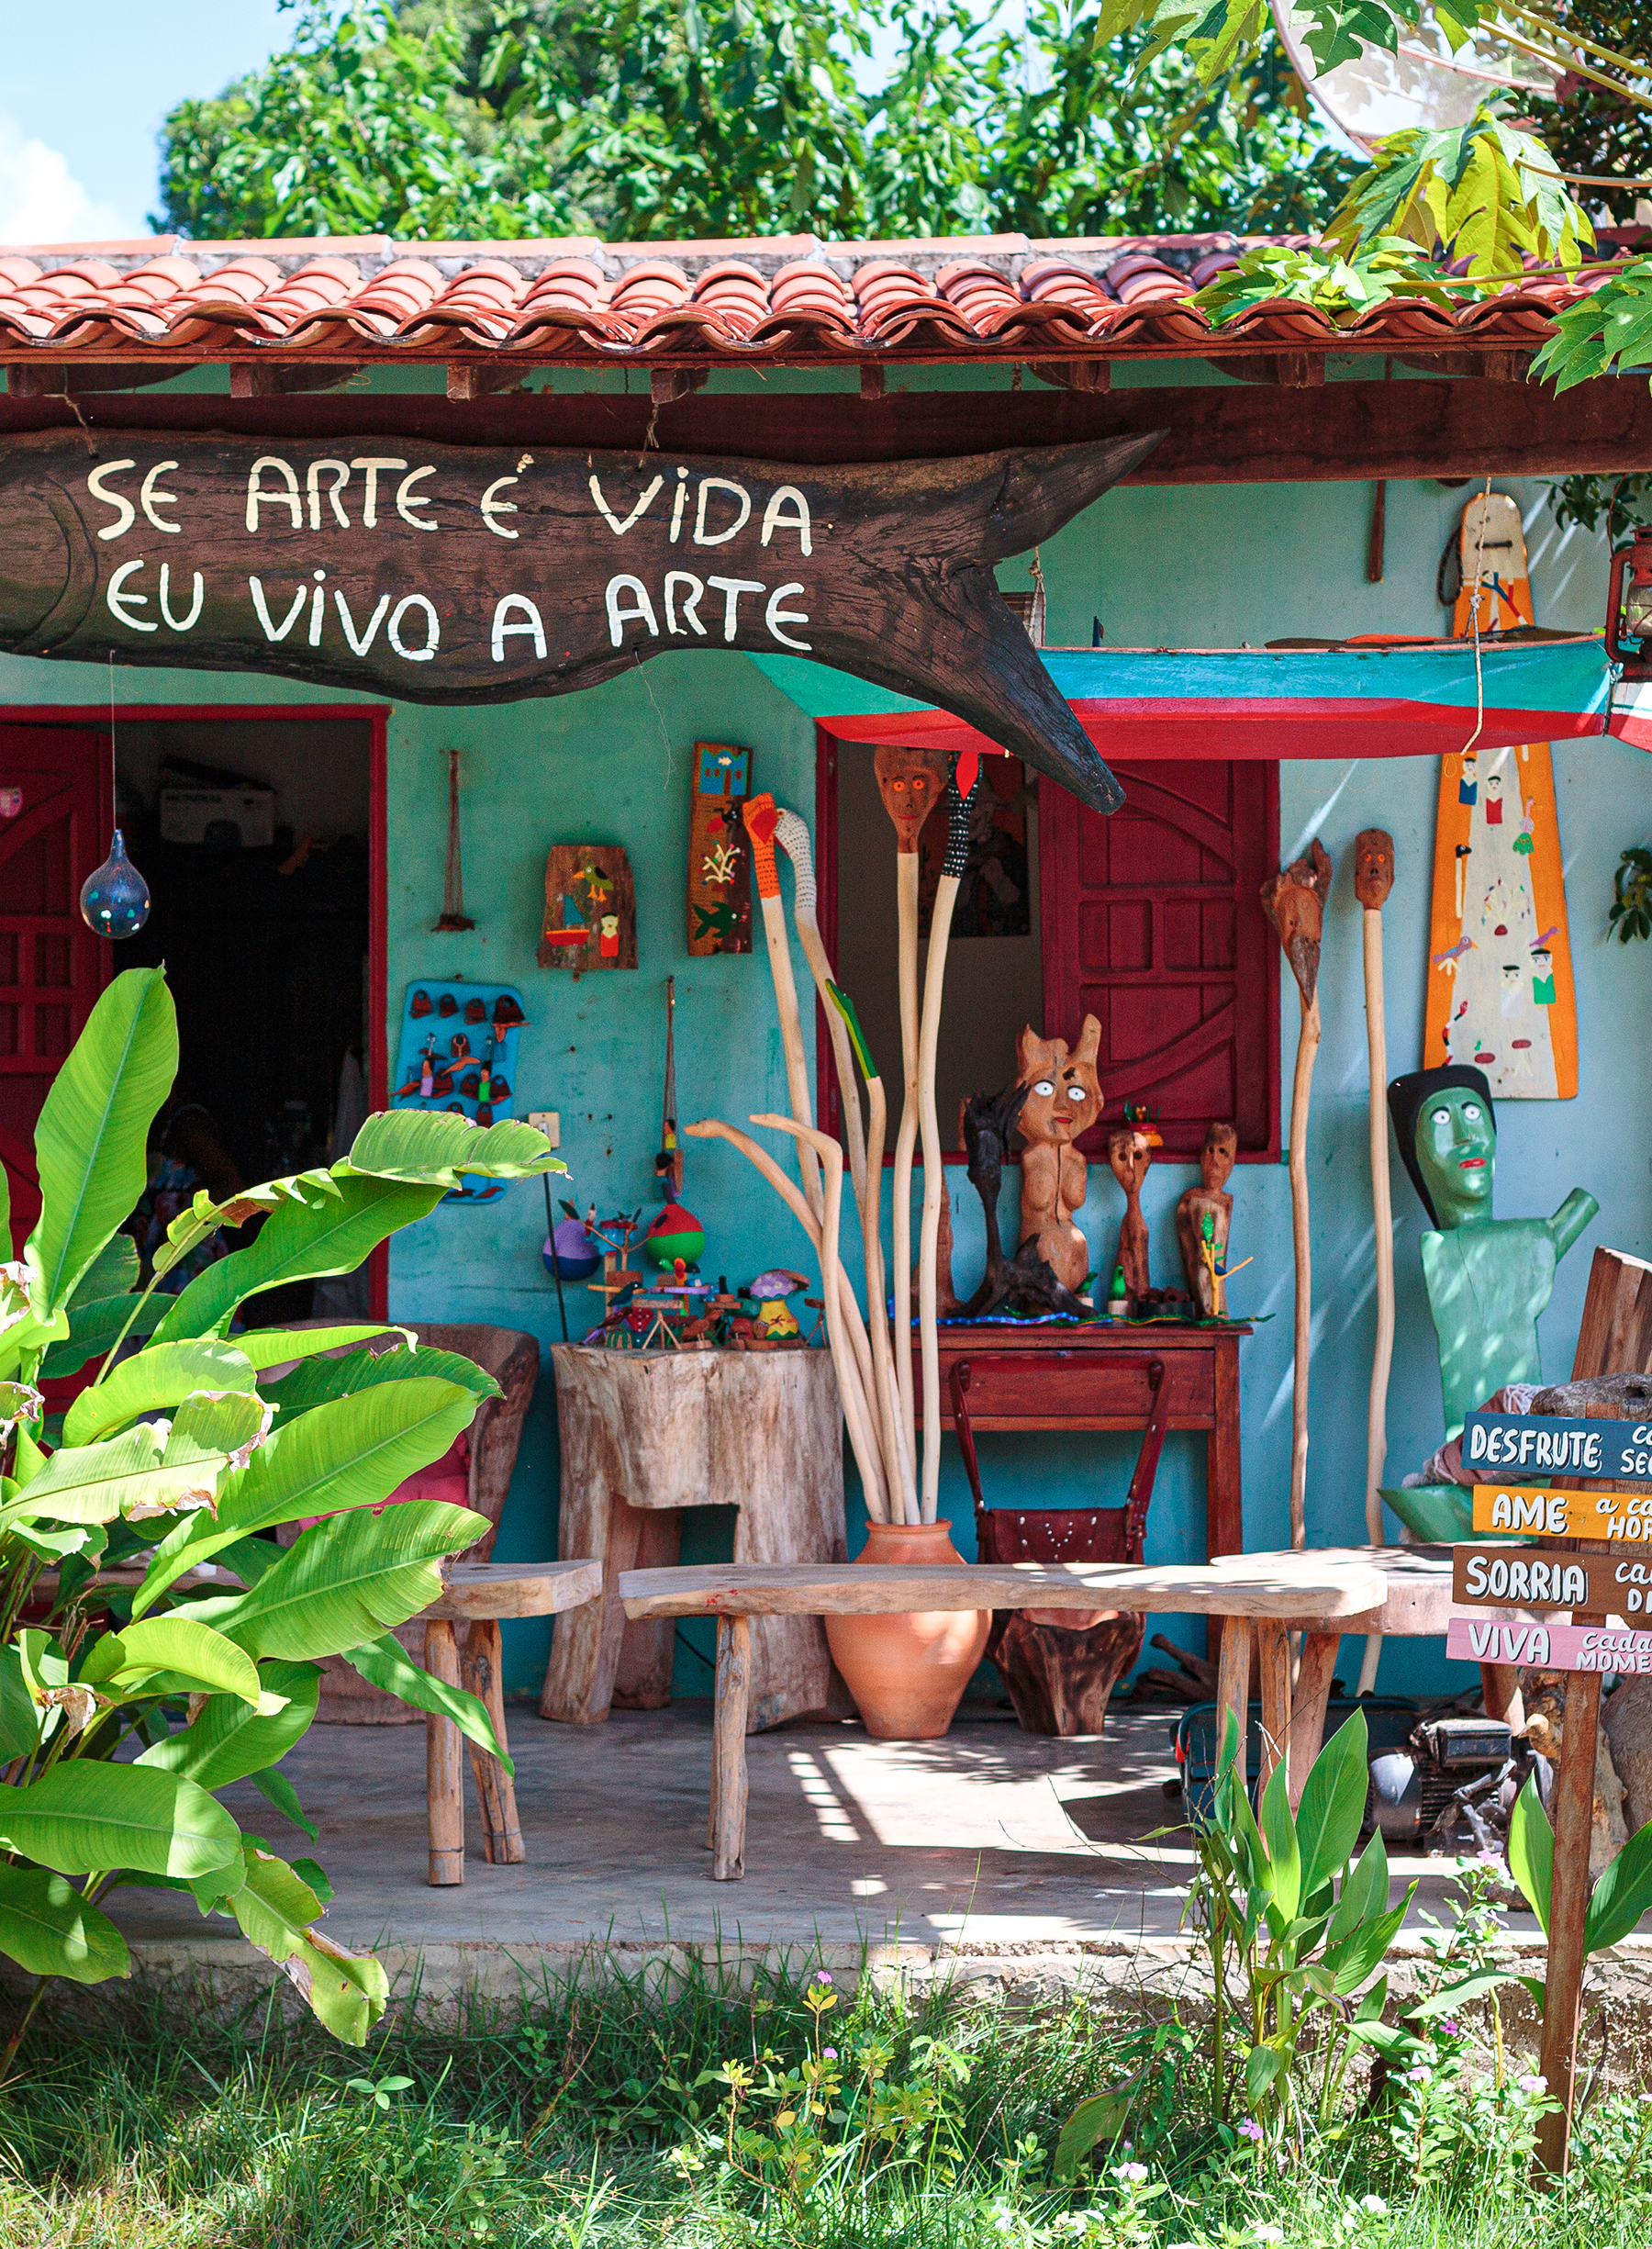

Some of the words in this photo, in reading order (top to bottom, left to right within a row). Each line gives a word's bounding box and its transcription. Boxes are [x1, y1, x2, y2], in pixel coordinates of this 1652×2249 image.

[88, 459, 182, 540] SE
[245, 455, 439, 533] ARTE
[480, 453, 534, 539] É
[106, 559, 204, 632] EU
[491, 593, 548, 662] A
[606, 570, 813, 651] ARTE
[1469, 1424, 1602, 1472] DESFRUTE
[1491, 1494, 1568, 1534] AME
[1595, 1497, 1619, 1515] a
[1466, 1556, 1588, 1606] SORRIA
[1468, 1622, 1551, 1664] VIVA
[1582, 1631, 1652, 1653] cada
[1576, 1650, 1651, 1673] MOME
